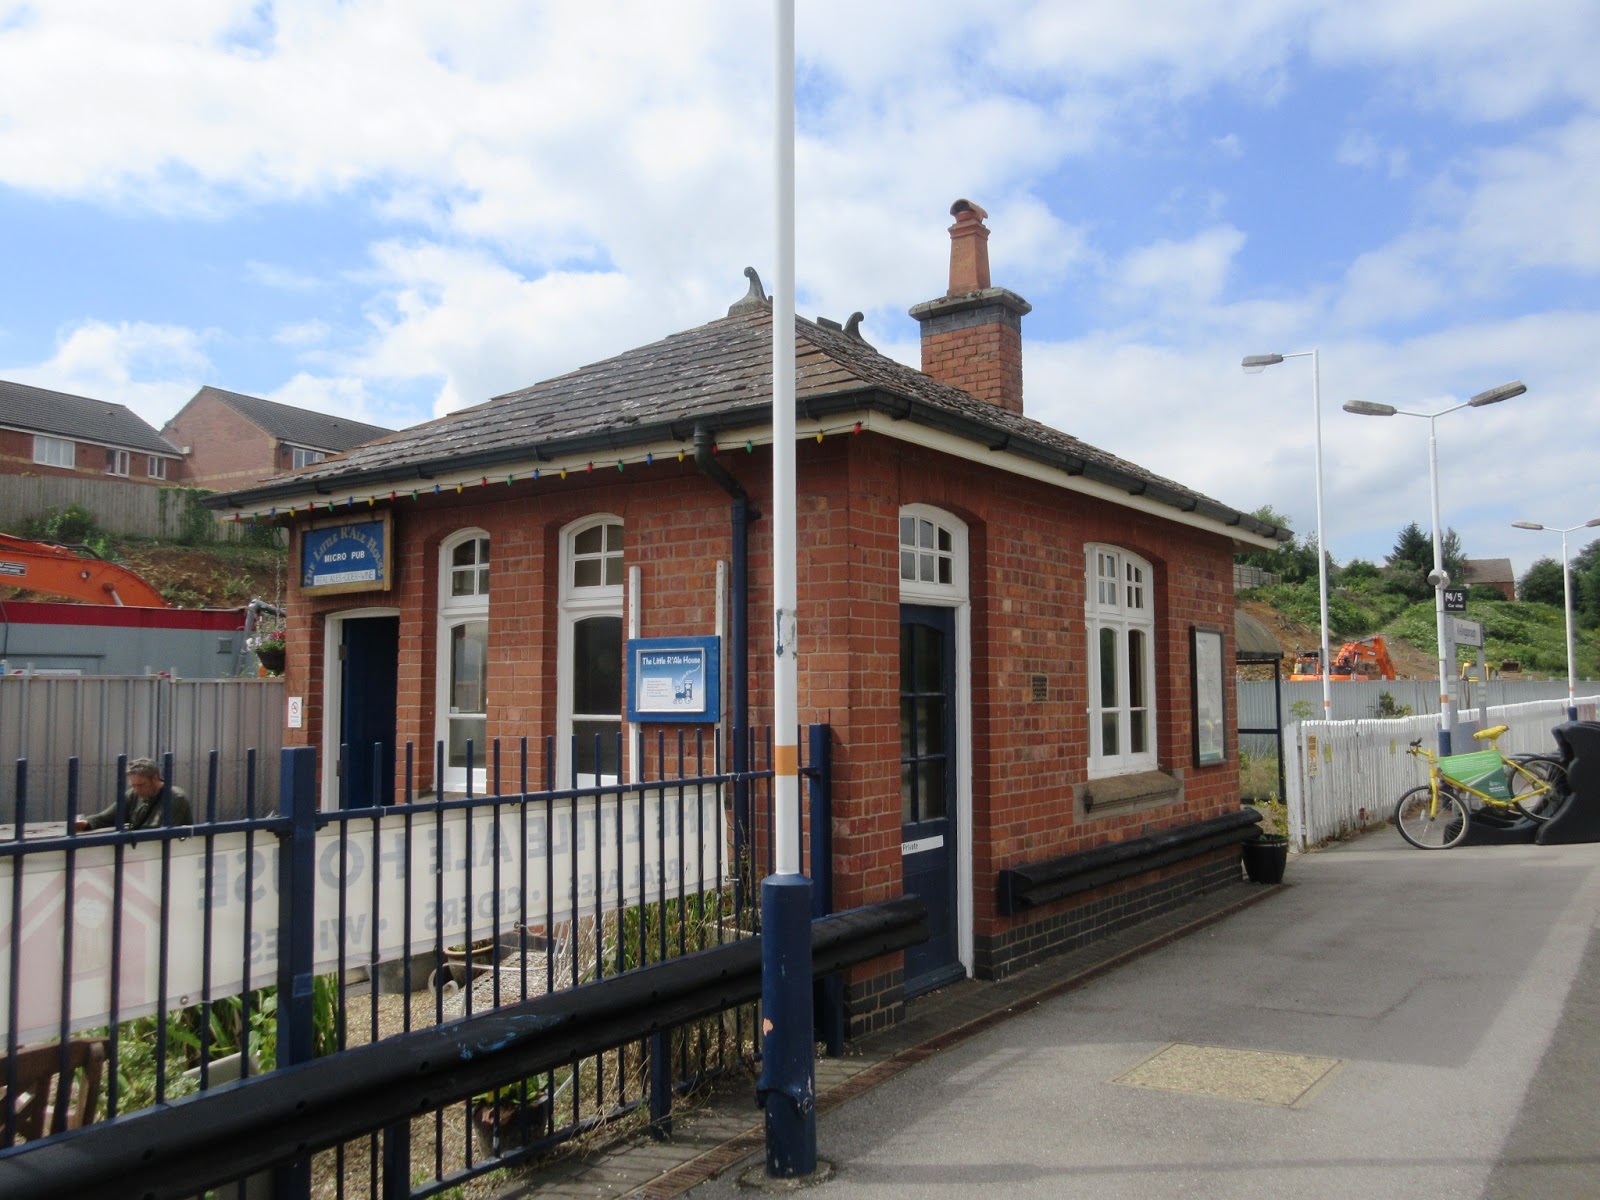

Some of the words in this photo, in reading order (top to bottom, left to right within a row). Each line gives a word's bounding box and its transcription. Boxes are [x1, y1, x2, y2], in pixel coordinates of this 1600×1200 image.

[324, 552, 347, 563] MICRO
[351, 550, 365, 560] PUB
[642, 657, 652, 665] The
[652, 657, 666, 665] Little
[667, 656, 682, 665] R'Ale
[683, 656, 700, 664] House
[902, 842, 918, 851] Private
